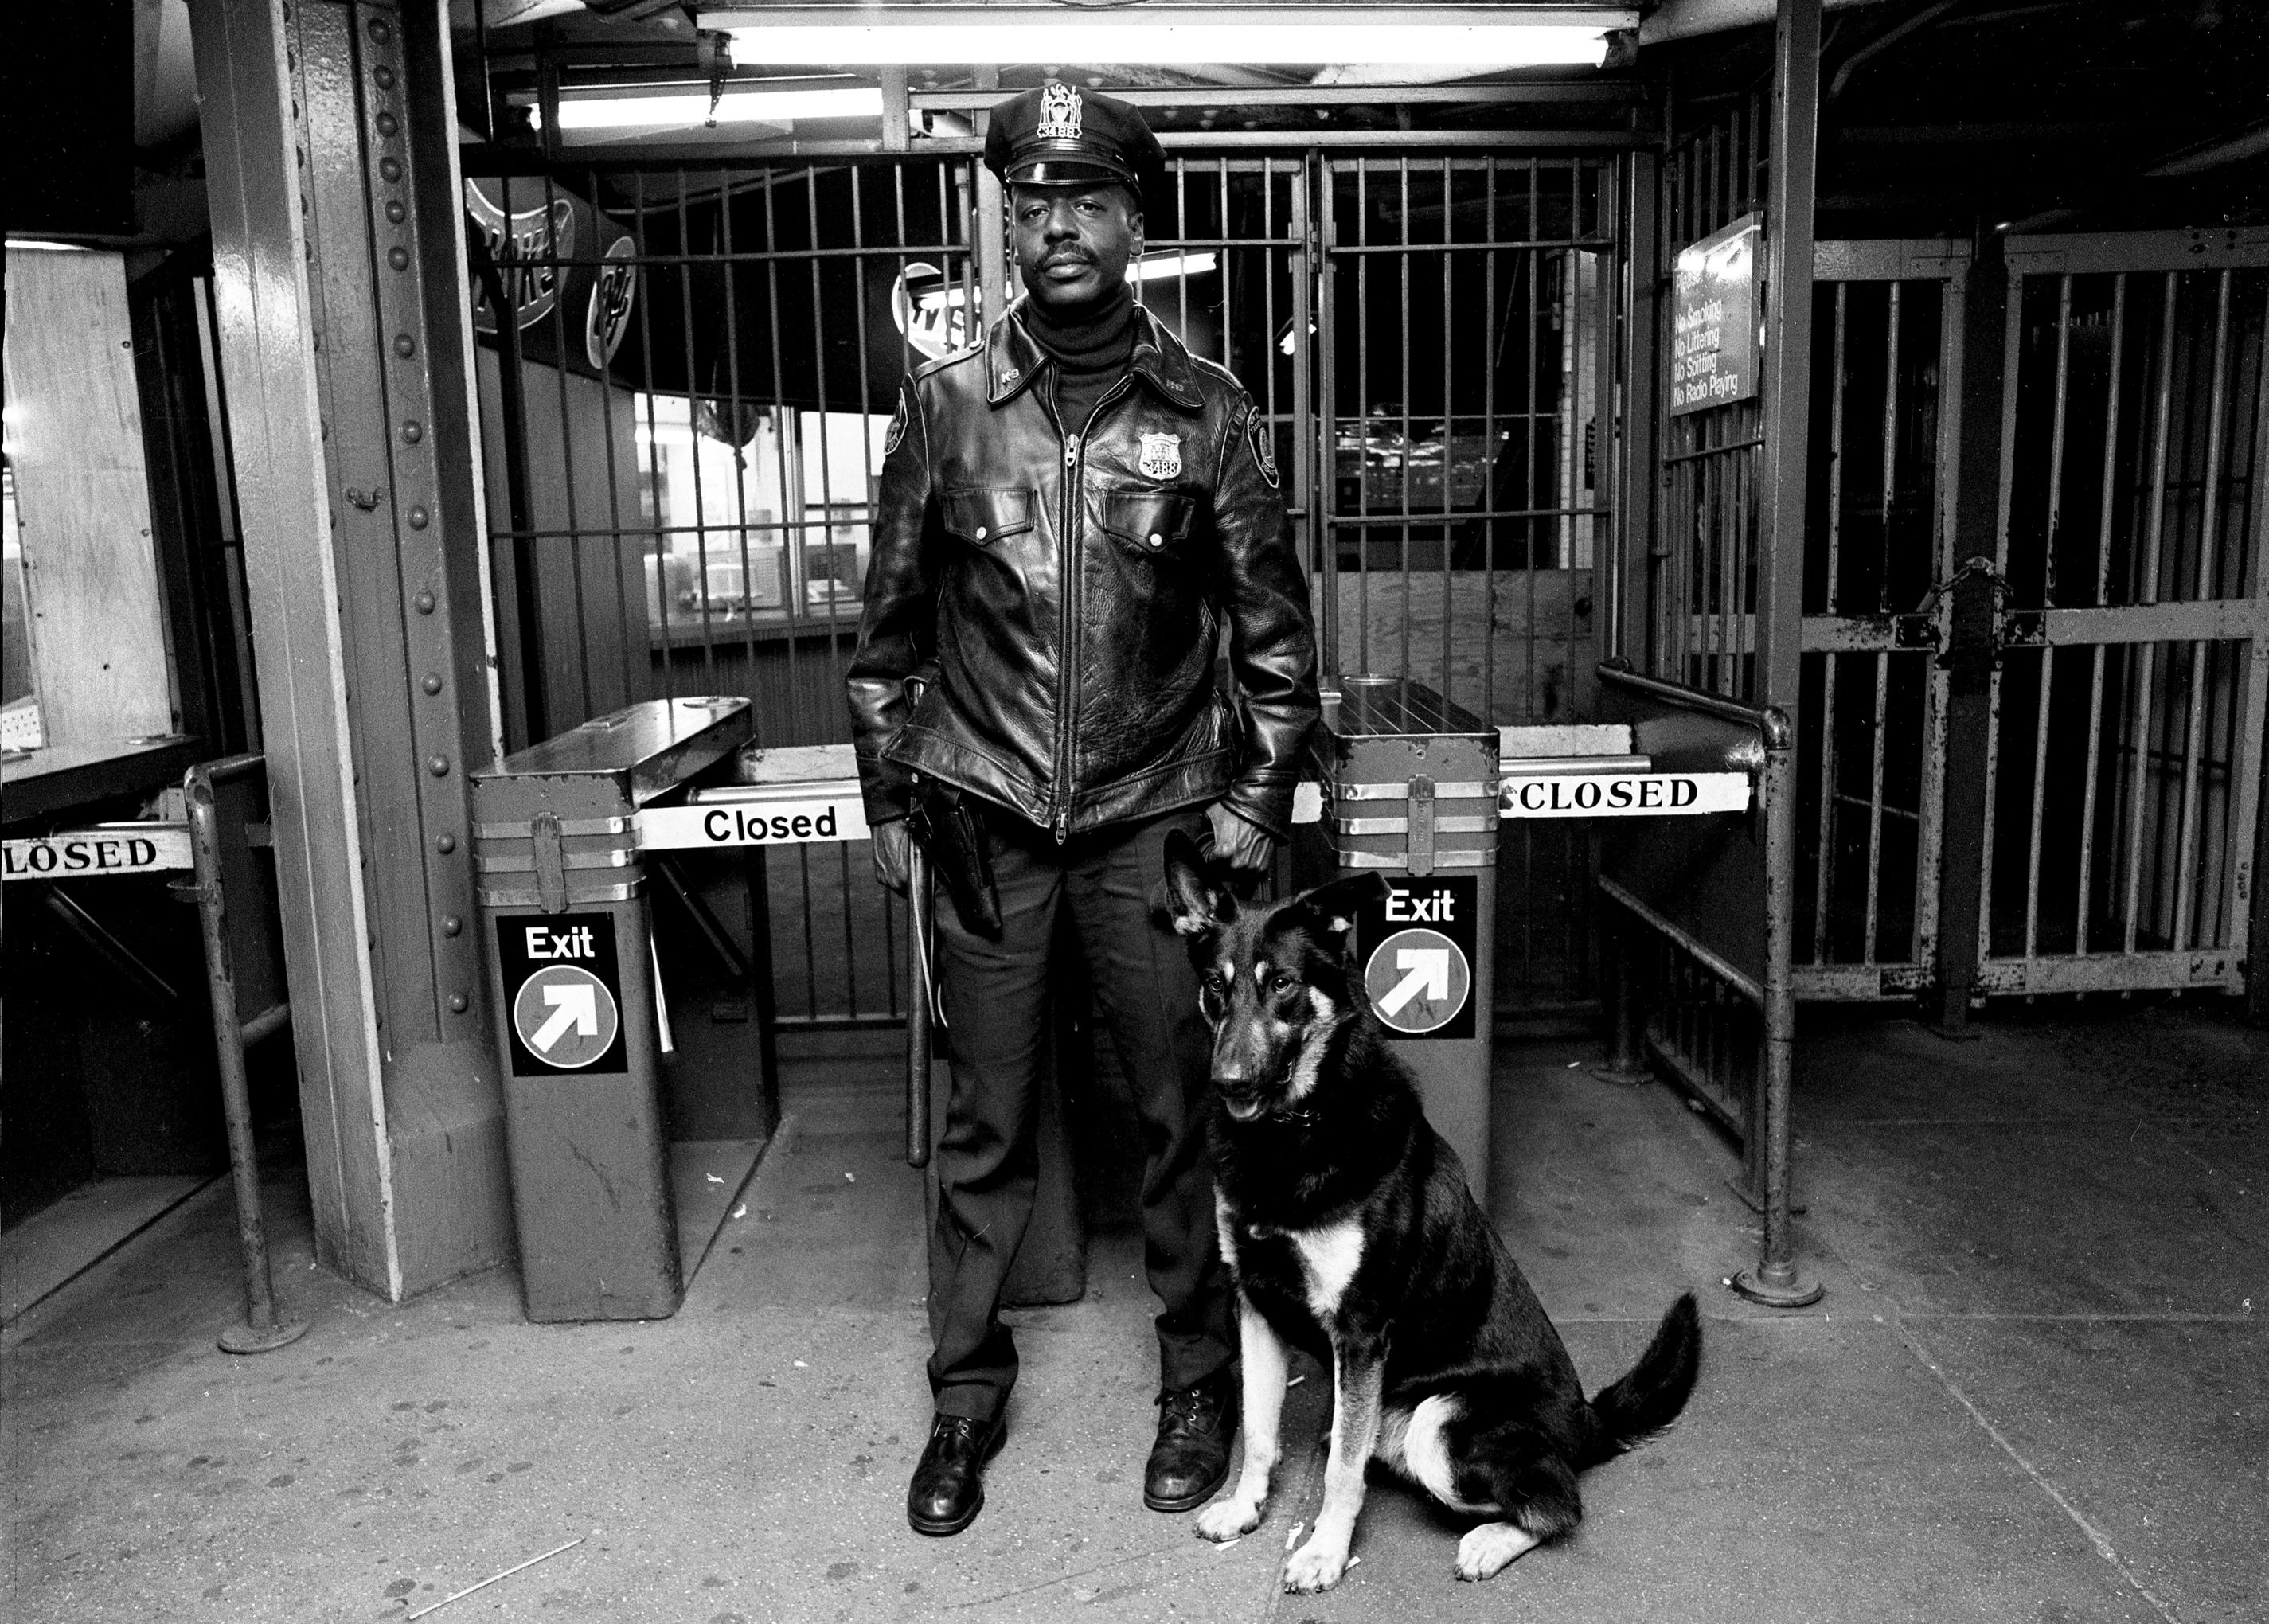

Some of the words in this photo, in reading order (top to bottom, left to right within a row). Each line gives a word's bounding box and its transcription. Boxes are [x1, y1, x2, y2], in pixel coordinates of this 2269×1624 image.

[1042, 127, 1076, 137] 3488
[1675, 313, 1685, 334] No
[1688, 299, 1721, 329] Smoking
[1675, 338, 1685, 359] No
[1687, 326, 1719, 354] Littering
[1001, 369, 1020, 384] K-9
[1674, 362, 1685, 383] No
[1686, 352, 1716, 381] Spitting
[1674, 386, 1685, 407] No
[1686, 379, 1708, 404] Radio
[1709, 370, 1738, 398] Playing
[1144, 461, 1177, 475] 3488
[1519, 779, 1698, 810] CLOSED
[704, 806, 837, 841] Closed
[1385, 889, 1455, 922] Exit
[525, 926, 596, 958] Exit
